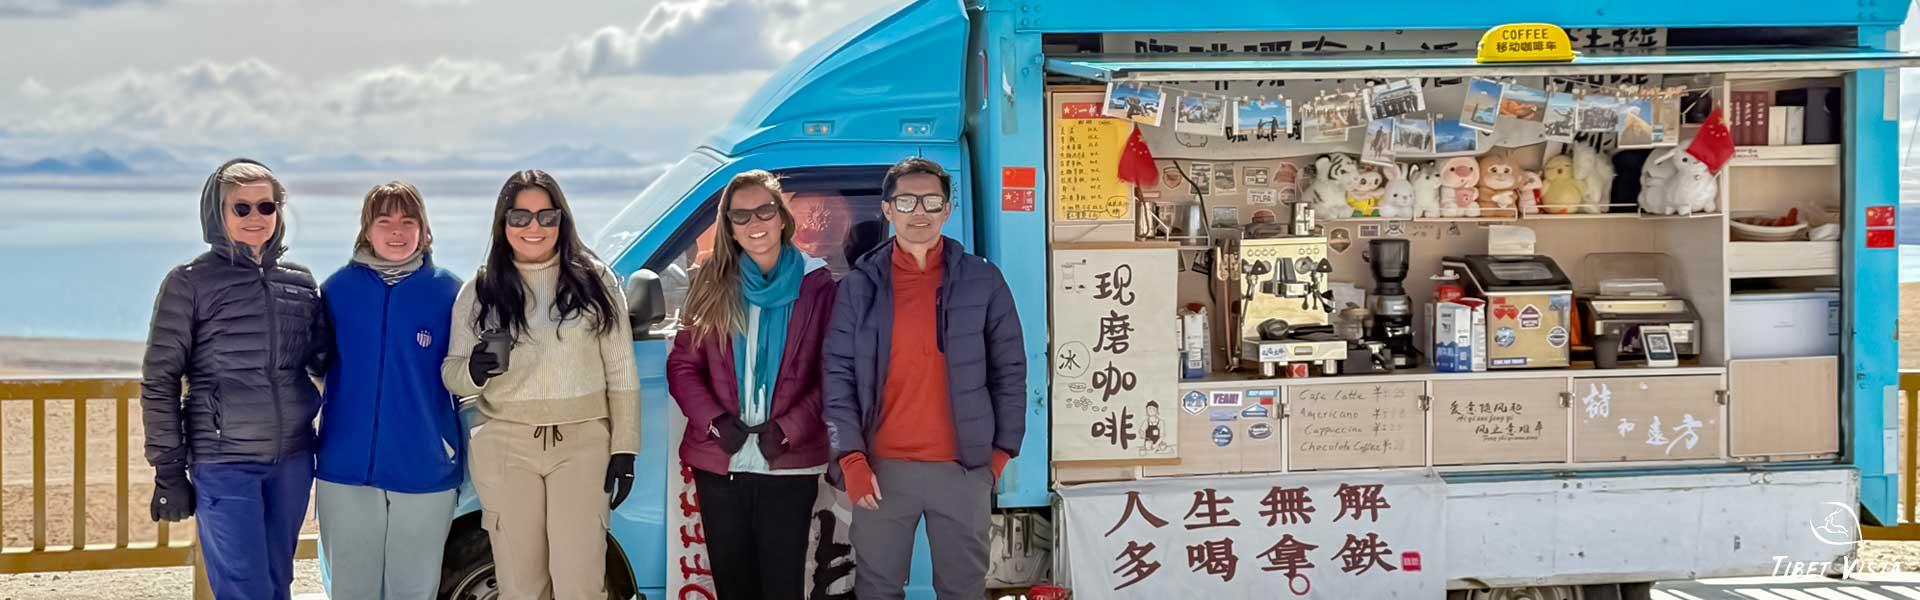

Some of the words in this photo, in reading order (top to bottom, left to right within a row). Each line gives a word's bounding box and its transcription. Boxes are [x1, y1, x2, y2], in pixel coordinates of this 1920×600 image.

[1502, 29, 1549, 40] COFFEE
[1497, 41, 1557, 52] 移动咖啡车
[1059, 350, 1081, 370] 冰
[1091, 264, 1137, 450] 现磨咖啡
[1213, 393, 1239, 404] YEAH!
[1105, 483, 1391, 537] 人生無解
